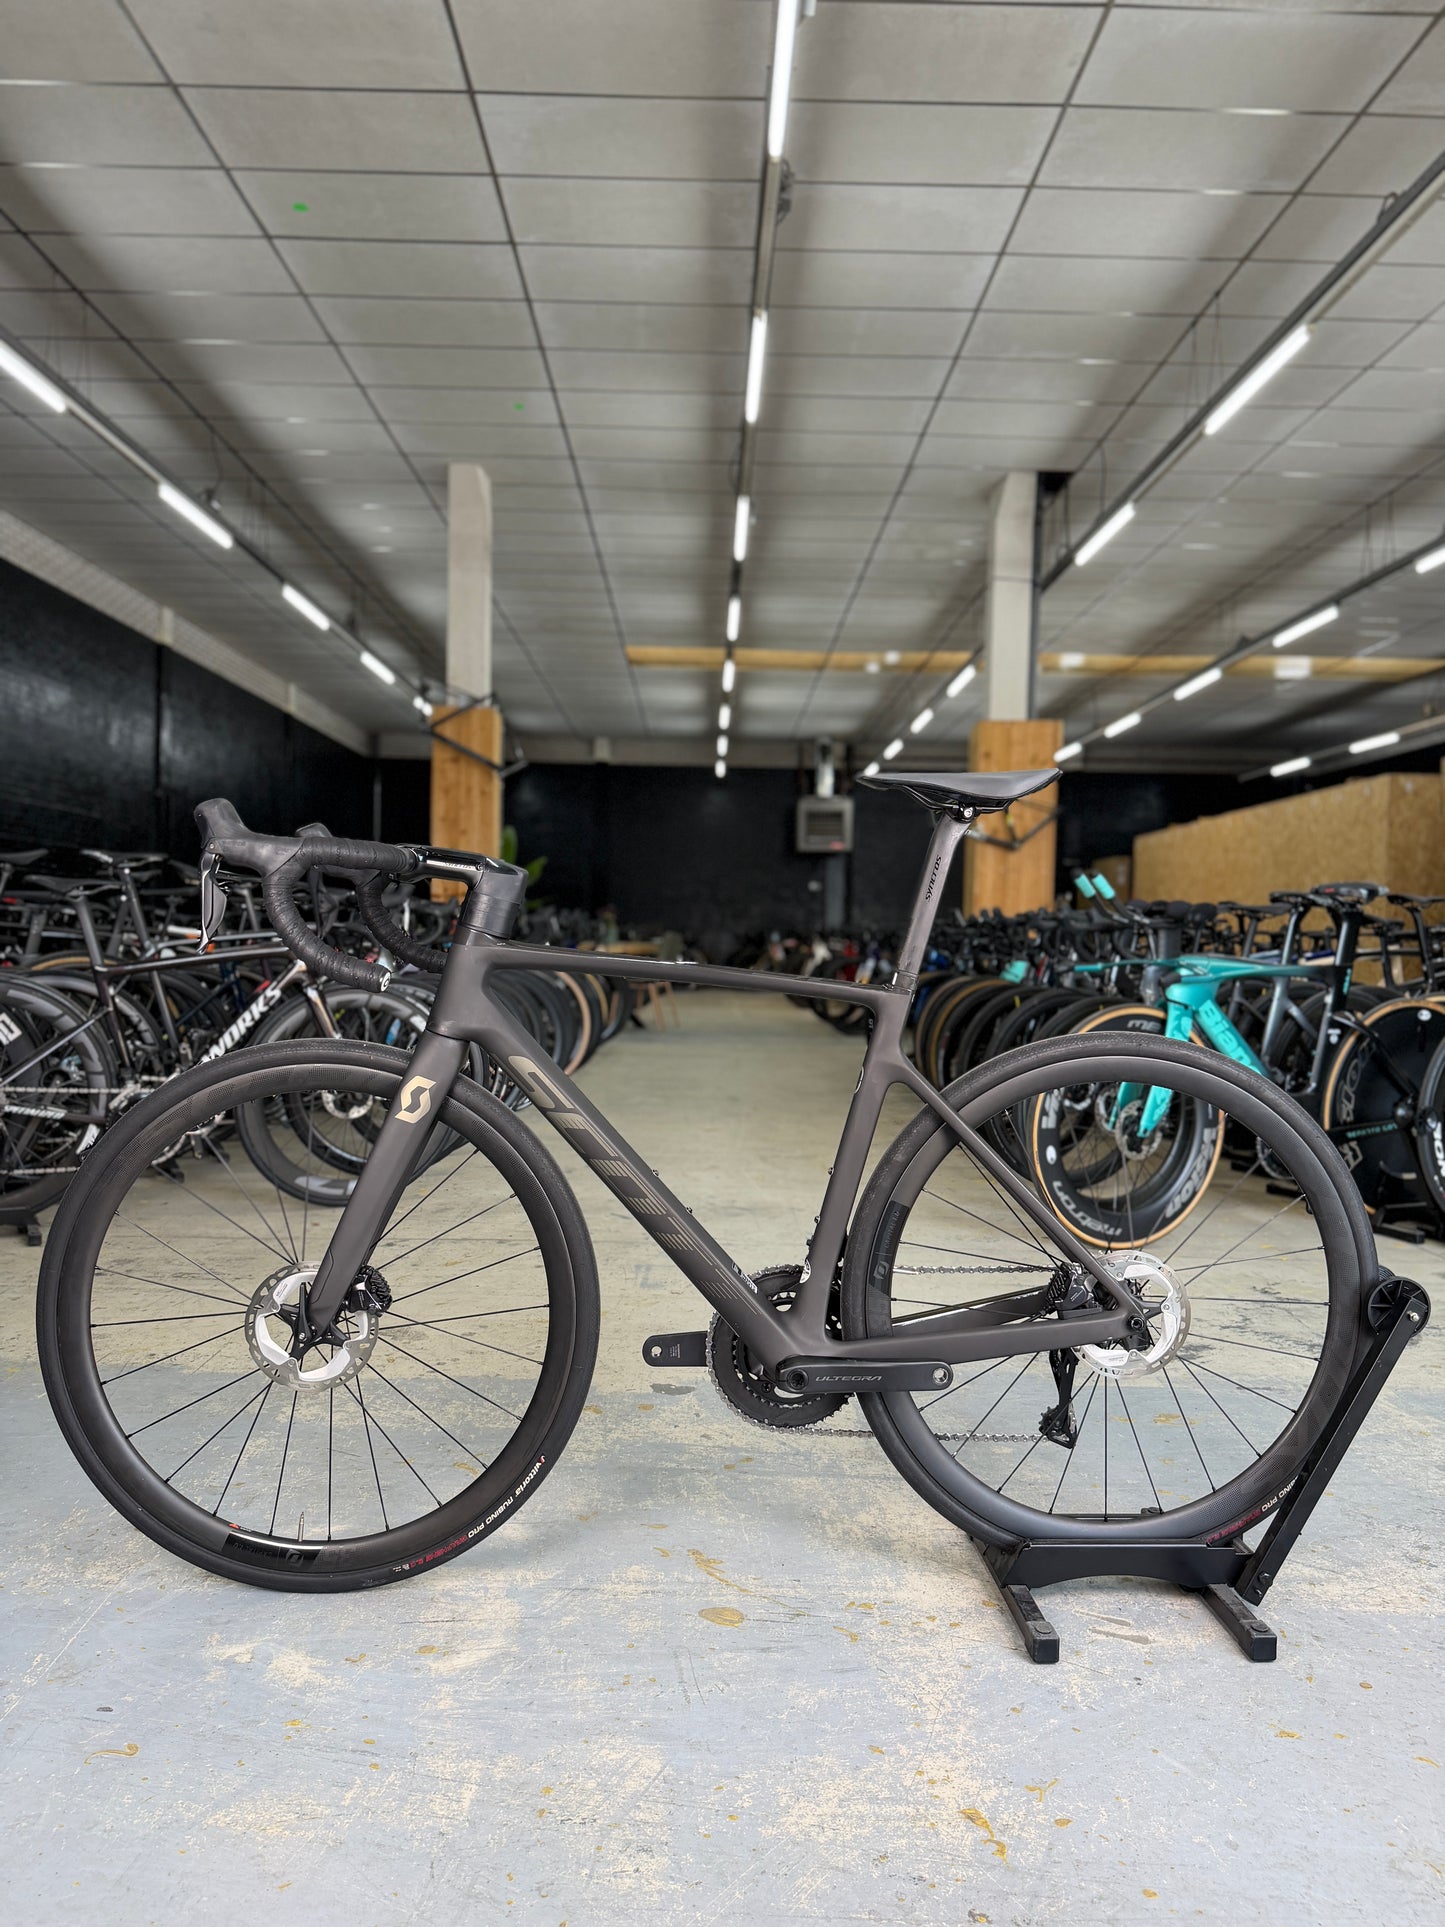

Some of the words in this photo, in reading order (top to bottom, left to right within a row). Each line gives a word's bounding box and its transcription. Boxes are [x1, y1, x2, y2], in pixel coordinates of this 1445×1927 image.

[508, 1055, 764, 1316] SCOTT
[815, 1375, 883, 1383] ULTEGRA
[485, 1496, 514, 1525] RUBINO
[1261, 1496, 1278, 1512] PRO
[467, 1522, 485, 1538] PRO
